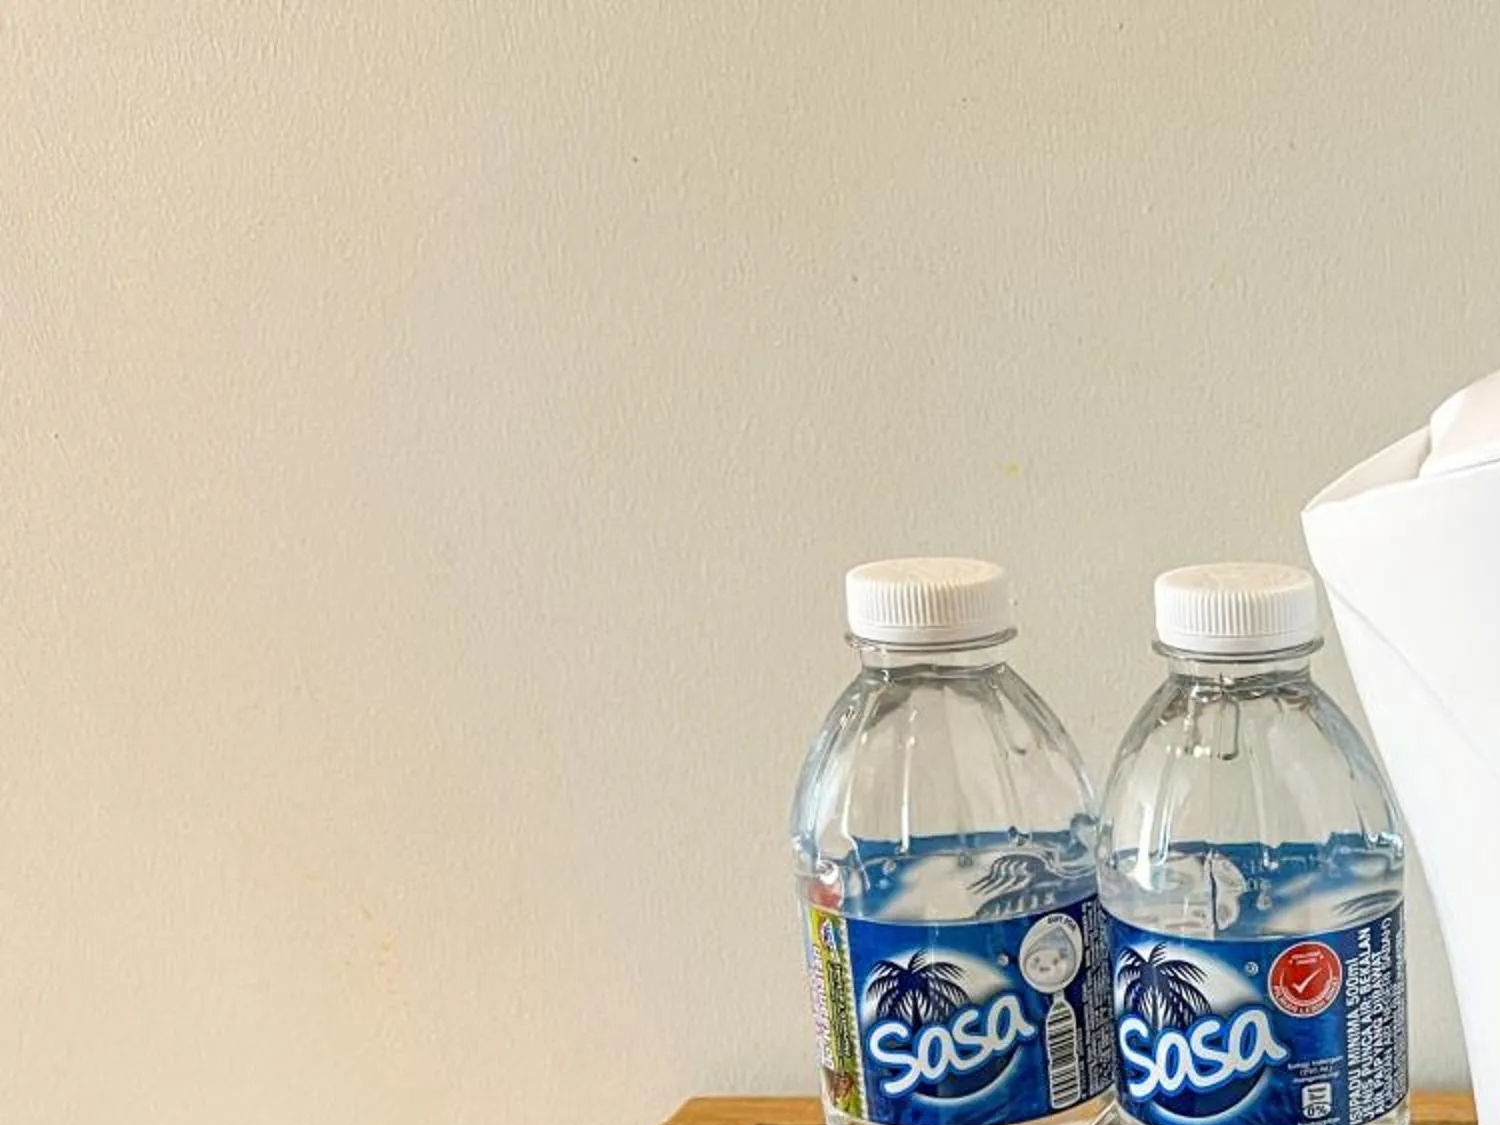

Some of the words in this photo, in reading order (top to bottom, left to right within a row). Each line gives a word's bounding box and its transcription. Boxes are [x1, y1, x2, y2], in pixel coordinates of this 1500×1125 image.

[1344, 957, 1359, 1006] 500ml
[1358, 927, 1371, 994] BEKALAN
[1346, 1008, 1360, 1066] MINIMA
[1361, 1025, 1373, 1077] PUNCA
[1348, 1069, 1361, 1125] ISIPADU
[1361, 1079, 1374, 1119] JENIS
